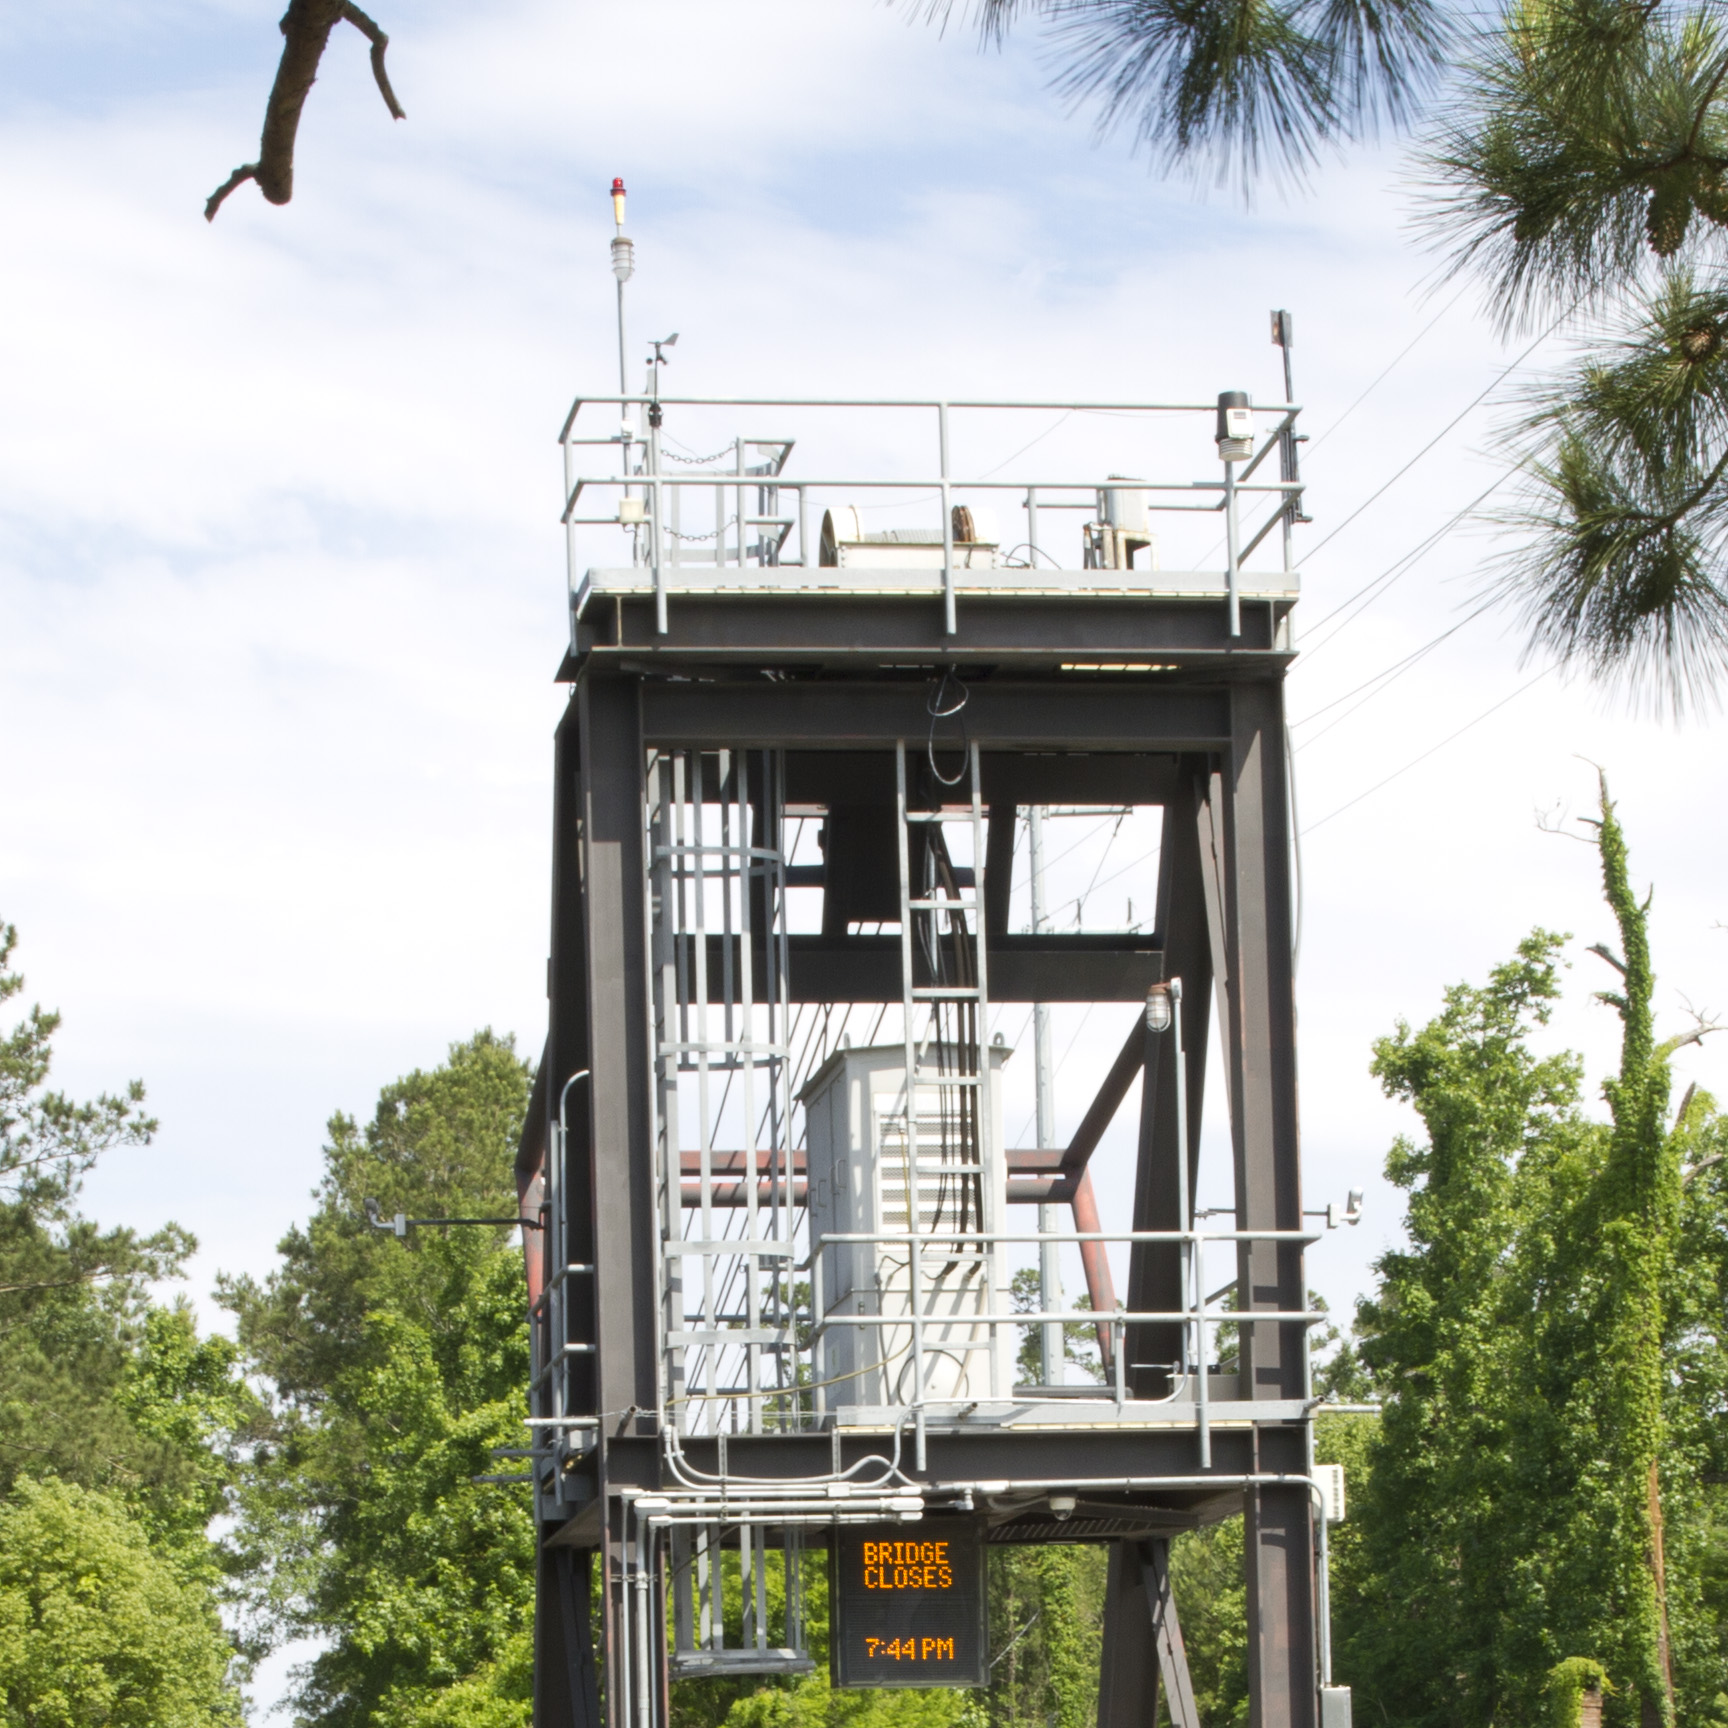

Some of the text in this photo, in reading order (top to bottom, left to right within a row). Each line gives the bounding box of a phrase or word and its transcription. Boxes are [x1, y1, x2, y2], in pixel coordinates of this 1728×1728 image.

[863, 1542, 949, 1565] BRIDGE
[864, 1566, 953, 1589] CLOSES
[865, 1637, 954, 1660] 7:44 PM
